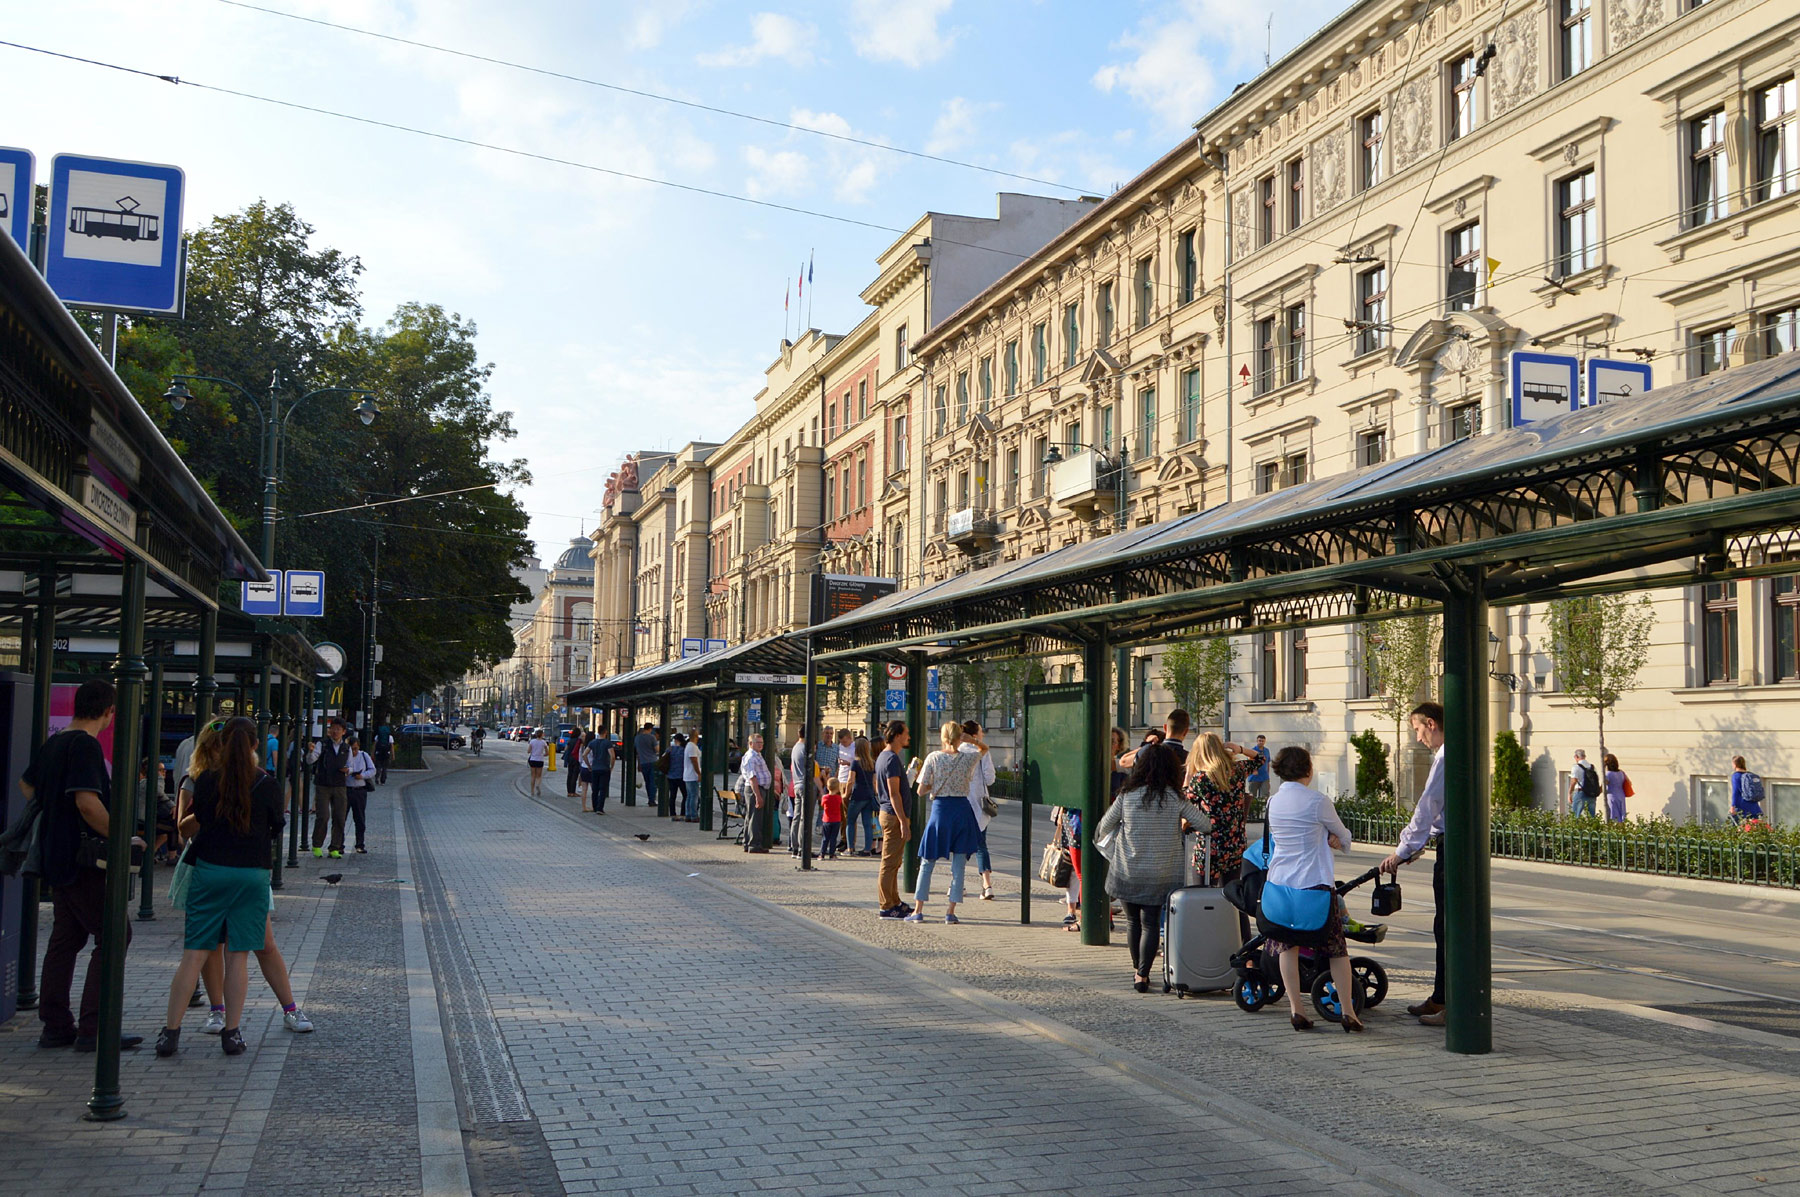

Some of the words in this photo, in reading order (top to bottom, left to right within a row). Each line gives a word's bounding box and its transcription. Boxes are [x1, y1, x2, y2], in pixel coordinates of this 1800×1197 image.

[91, 483, 113, 519] DWORZEC
[849, 581, 866, 589] Główny
[53, 639, 67, 650] 902
